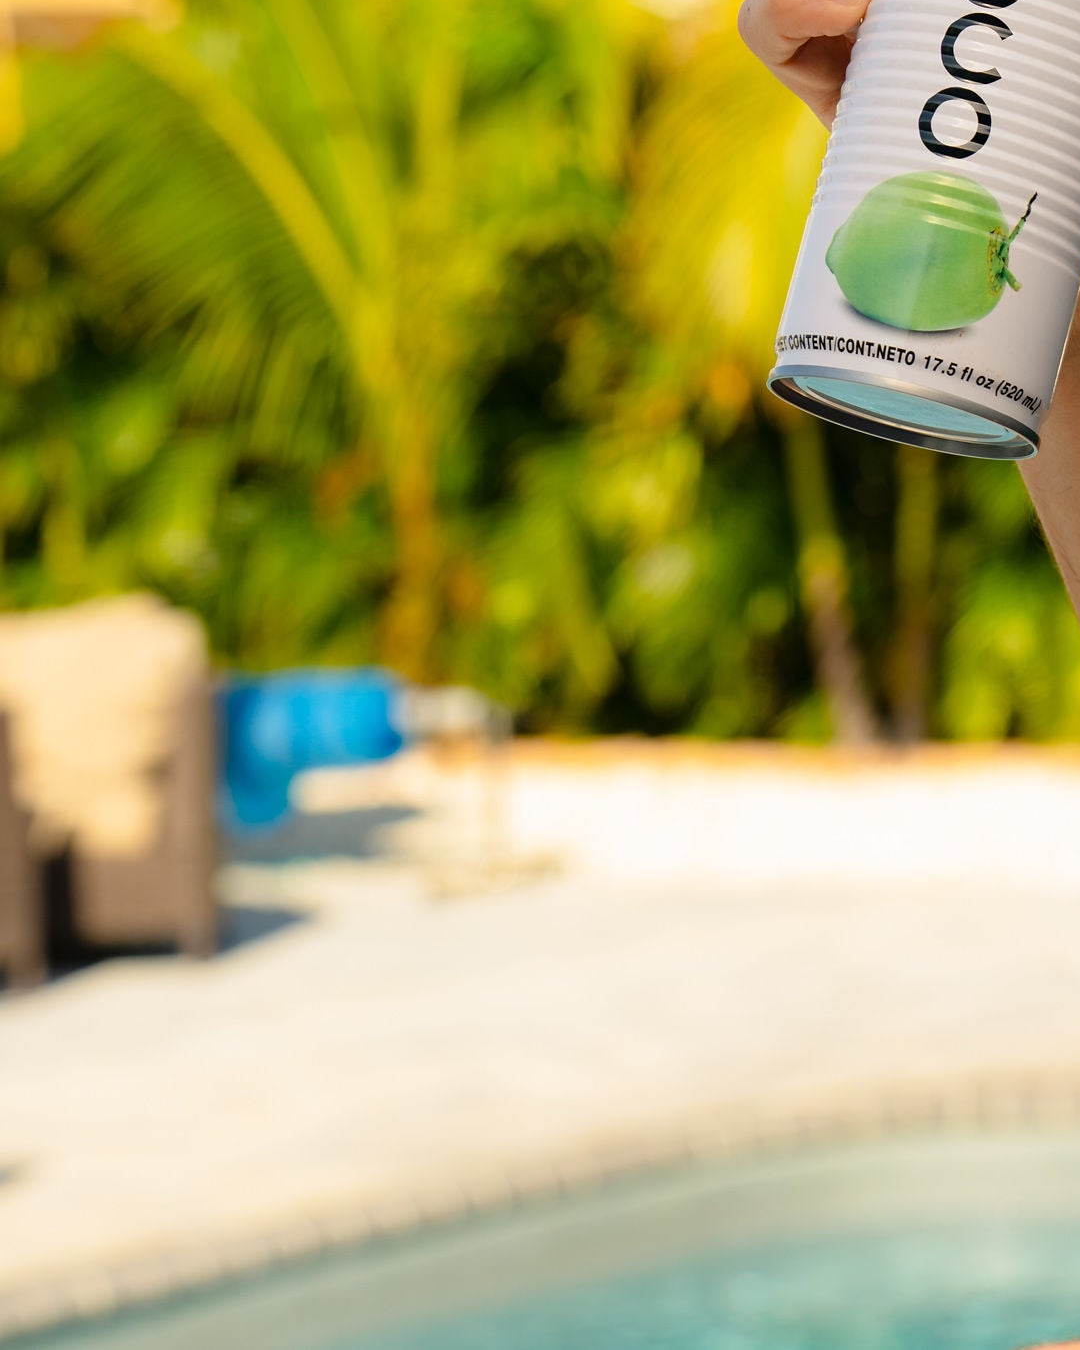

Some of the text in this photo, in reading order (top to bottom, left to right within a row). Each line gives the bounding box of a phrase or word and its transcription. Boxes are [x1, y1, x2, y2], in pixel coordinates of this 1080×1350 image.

[924, 355, 958, 376] 17.5
[960, 367, 974, 382] fl
[975, 375, 995, 390] oz
[995, 379, 1024, 402] (520
[1021, 395, 1042, 415] mL)
